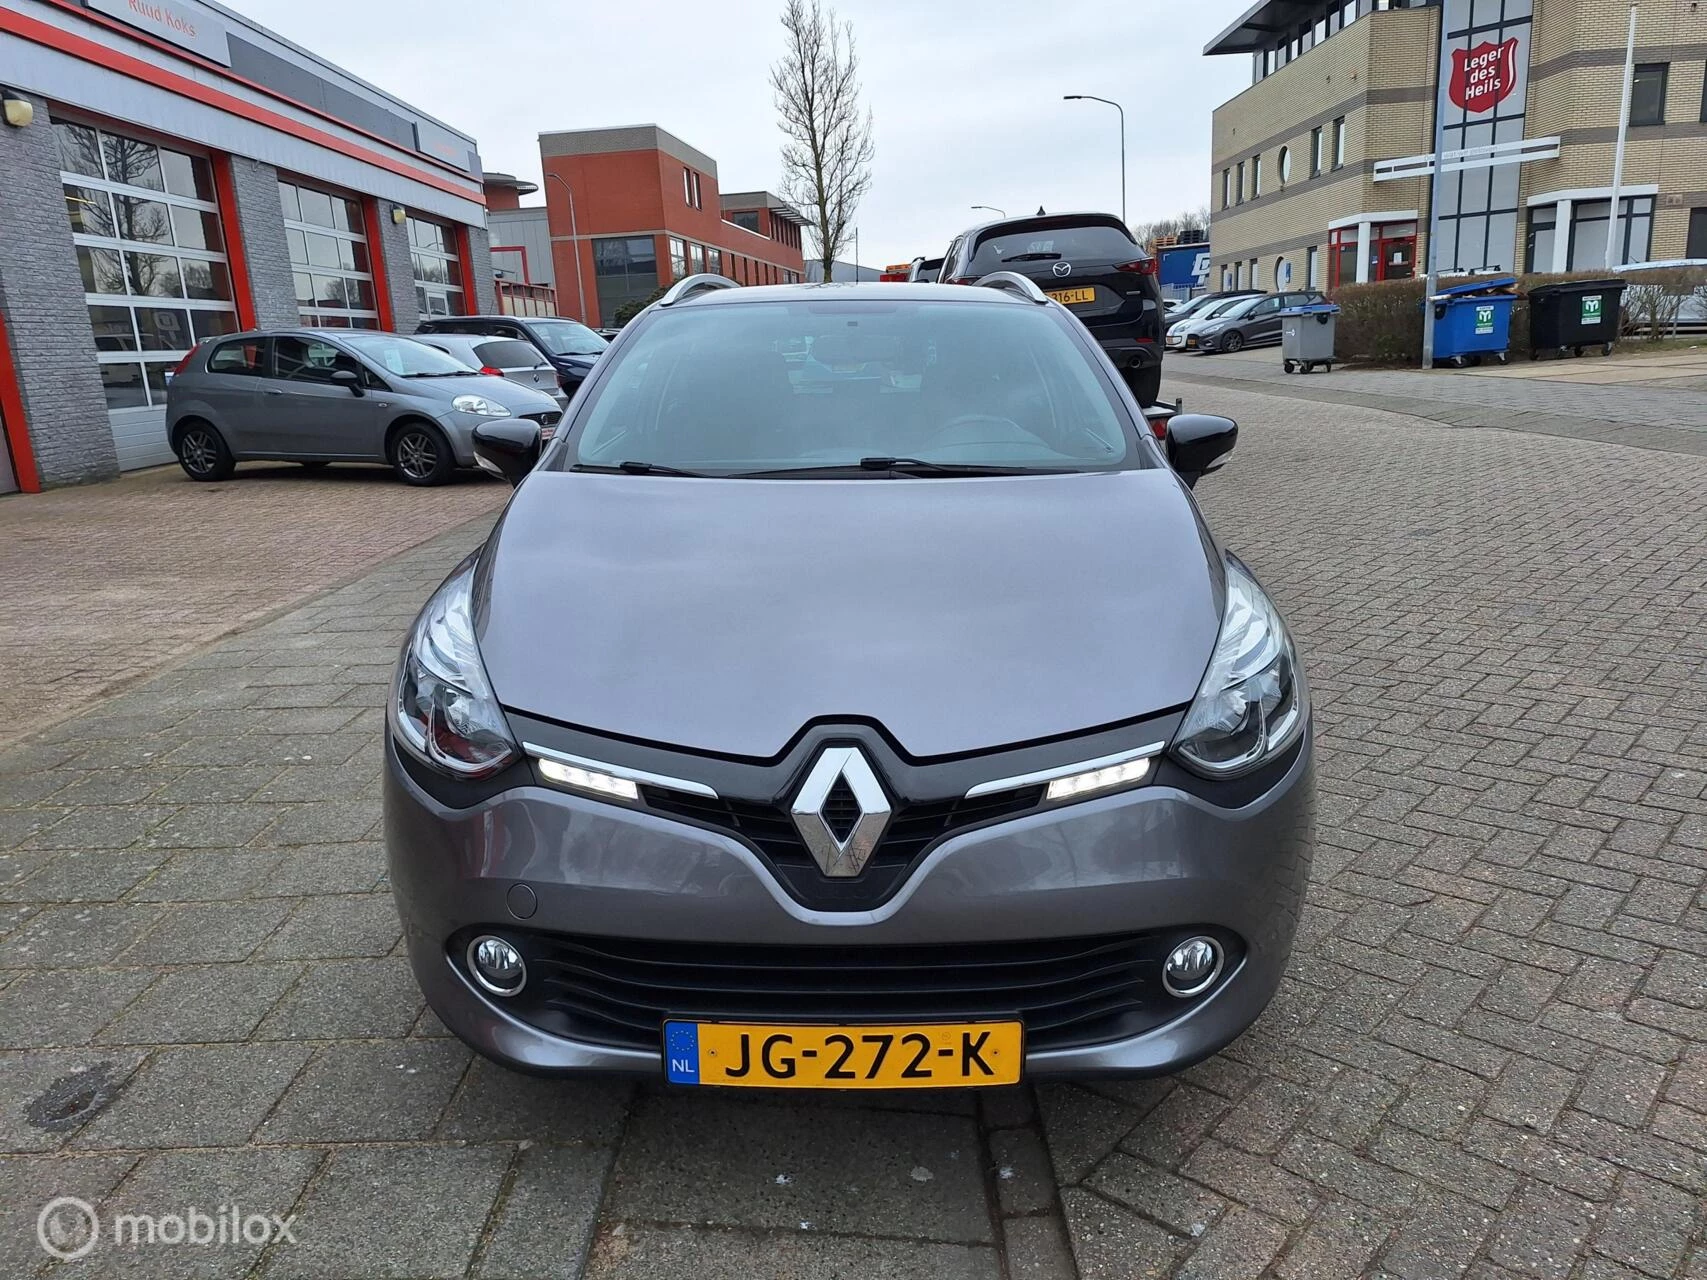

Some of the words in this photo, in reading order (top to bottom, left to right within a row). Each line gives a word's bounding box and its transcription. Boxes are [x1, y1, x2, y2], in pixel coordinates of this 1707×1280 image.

[128, 0, 161, 21] Ruud
[164, 9, 196, 37] Koks
[1463, 46, 1505, 72] Leger
[1470, 65, 1496, 84] des
[1465, 78, 1501, 100] Heils
[672, 1058, 695, 1073] NL
[725, 1031, 995, 1080] JG-272-K
